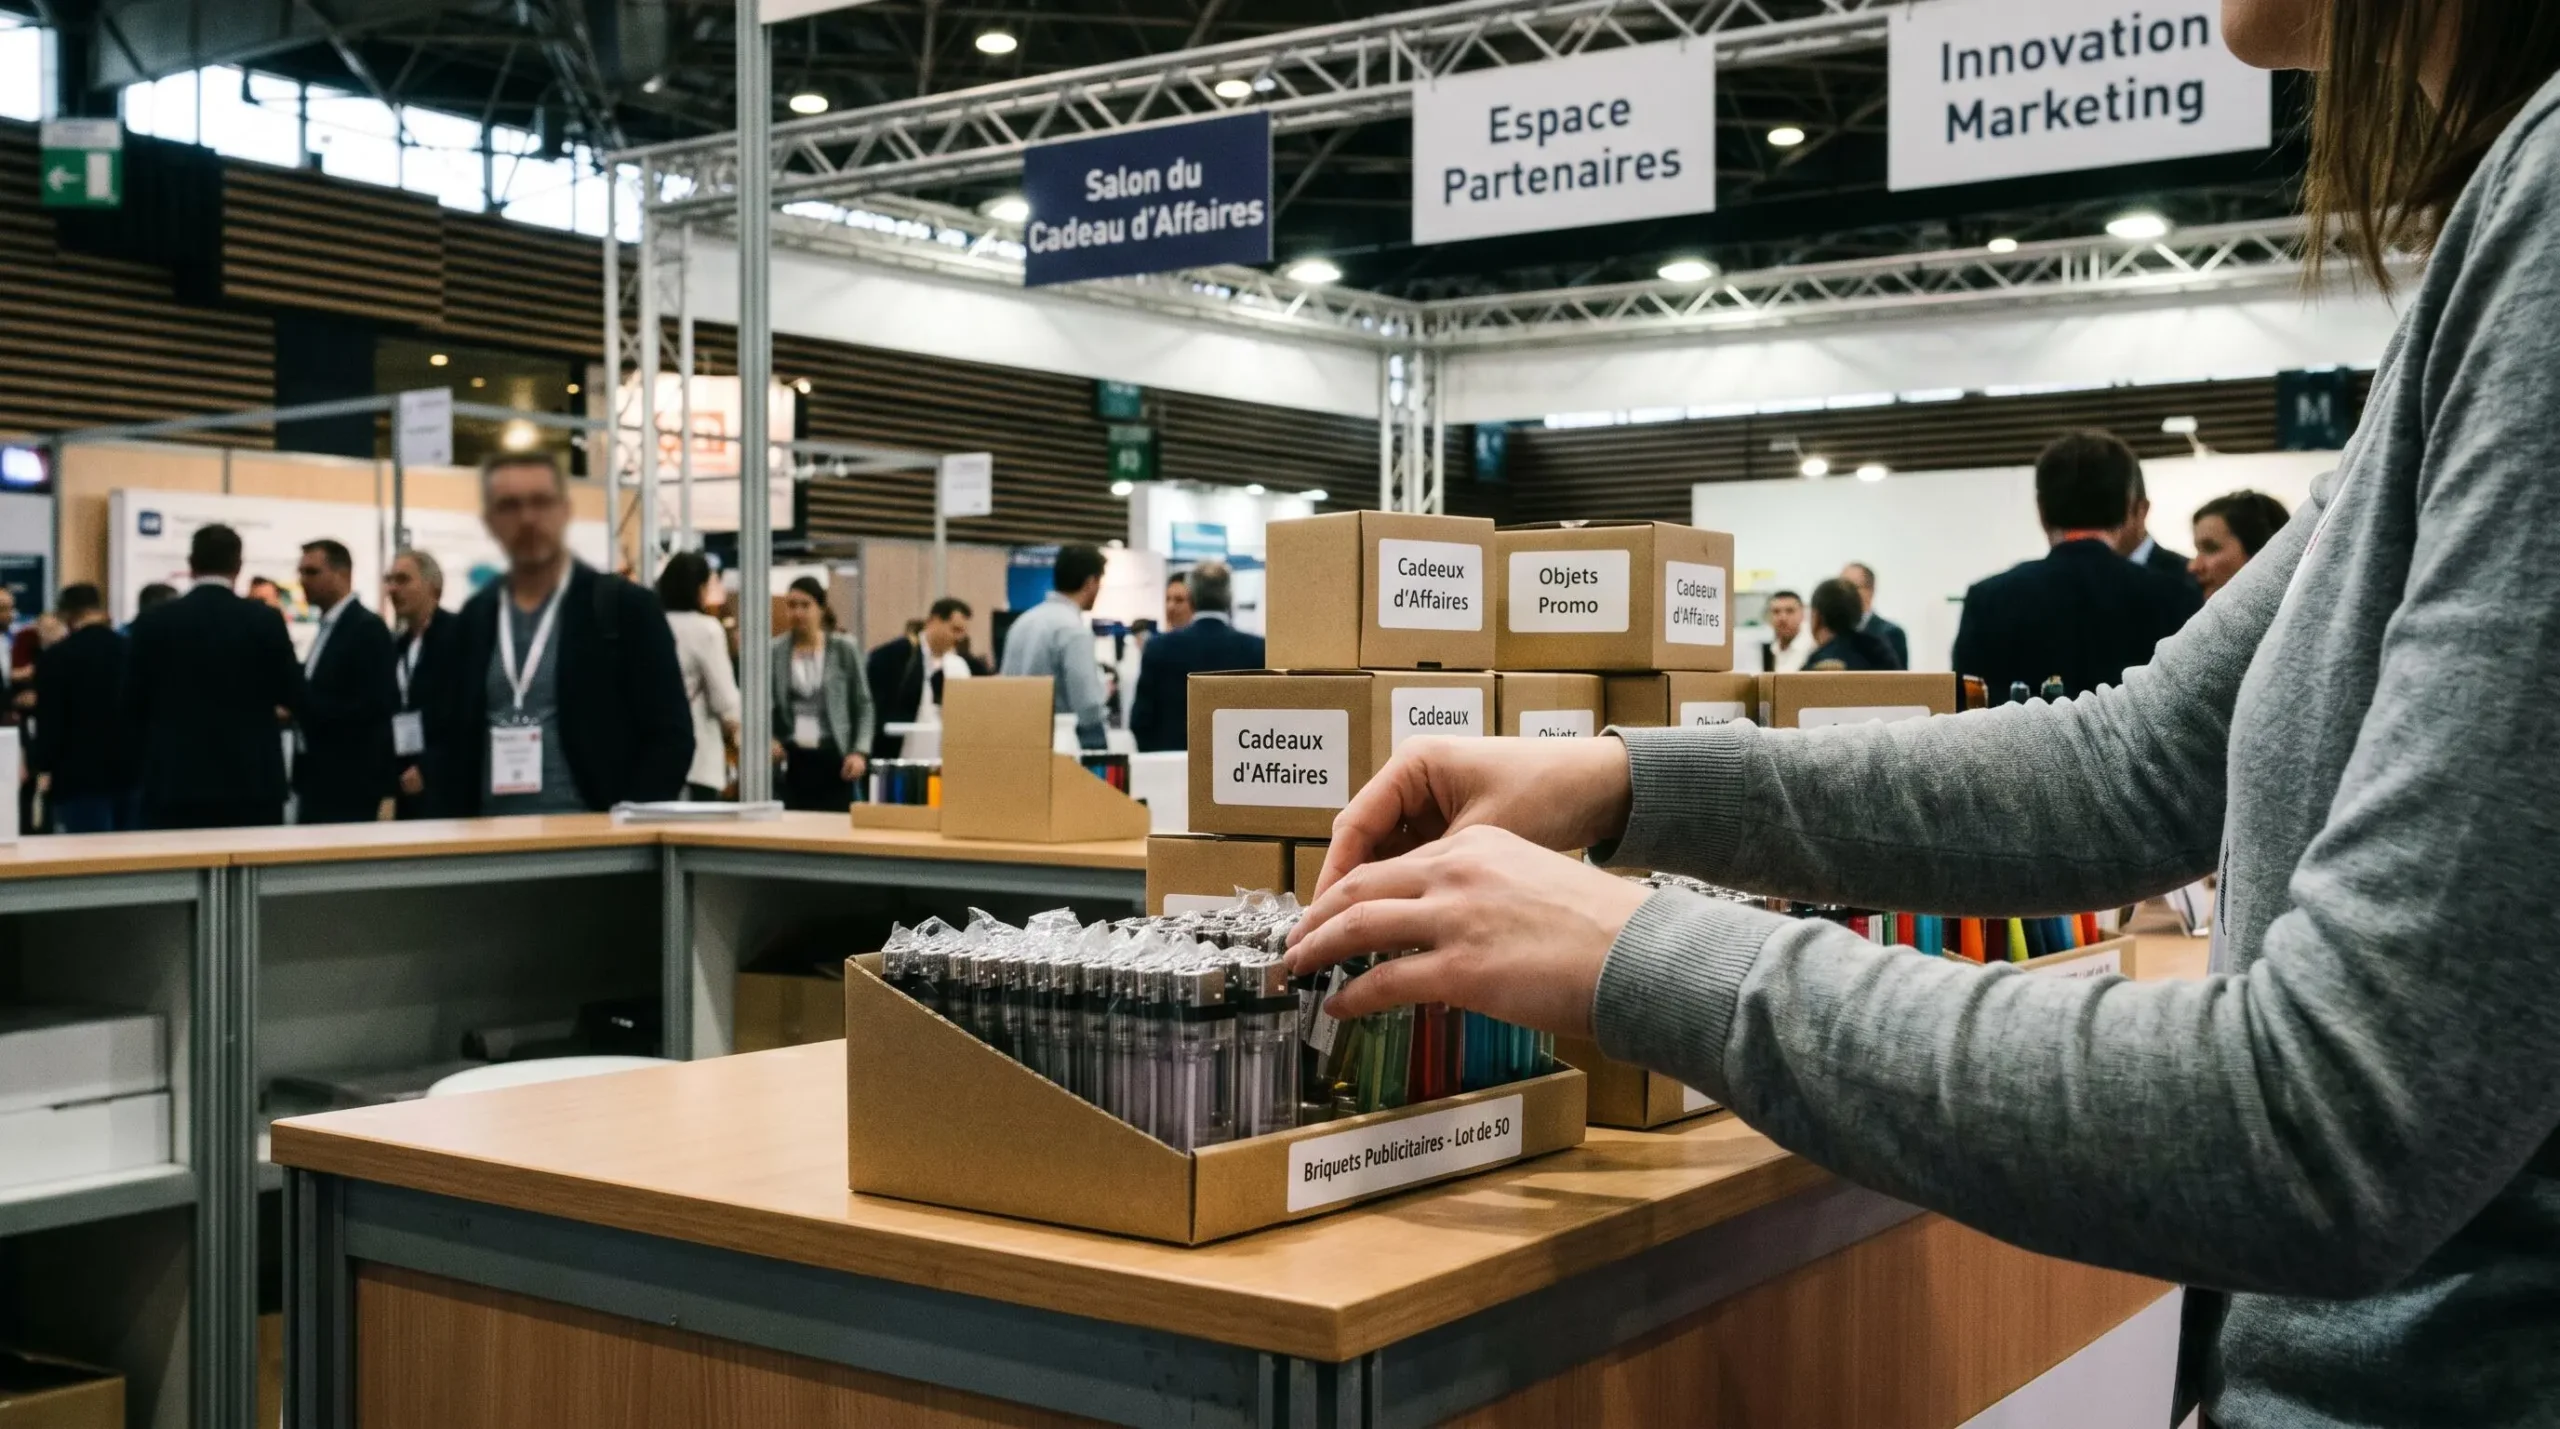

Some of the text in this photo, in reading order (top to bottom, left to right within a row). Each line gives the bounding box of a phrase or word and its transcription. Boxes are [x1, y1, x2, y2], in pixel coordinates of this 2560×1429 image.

[1941, 12, 2209, 83] Innovation
[1946, 77, 2204, 144] Marketing
[1489, 98, 1631, 147] Espace
[1085, 156, 1202, 202] Salon du
[1443, 147, 1682, 206] Partenaires
[1028, 198, 1265, 254] Cadeau d'Affaires
[1398, 557, 1465, 579] Cadeeux
[1539, 566, 1599, 588] Objets
[1393, 588, 1469, 611] d'Affaires
[1676, 578, 1718, 599] Cadeeux
[1538, 596, 1599, 615] Promo
[1672, 605, 1720, 628] d'Affaires
[1408, 705, 1470, 726] Cadeaux
[1238, 728, 1323, 751] Cadeaux
[1232, 761, 1328, 785] d'Affaires
[1304, 1153, 1361, 1182] Briquets
[1364, 1134, 1444, 1168] Publicitaires
[1455, 1127, 1475, 1147] Lot
[1477, 1121, 1492, 1142] de
[1494, 1116, 1510, 1138] 50
